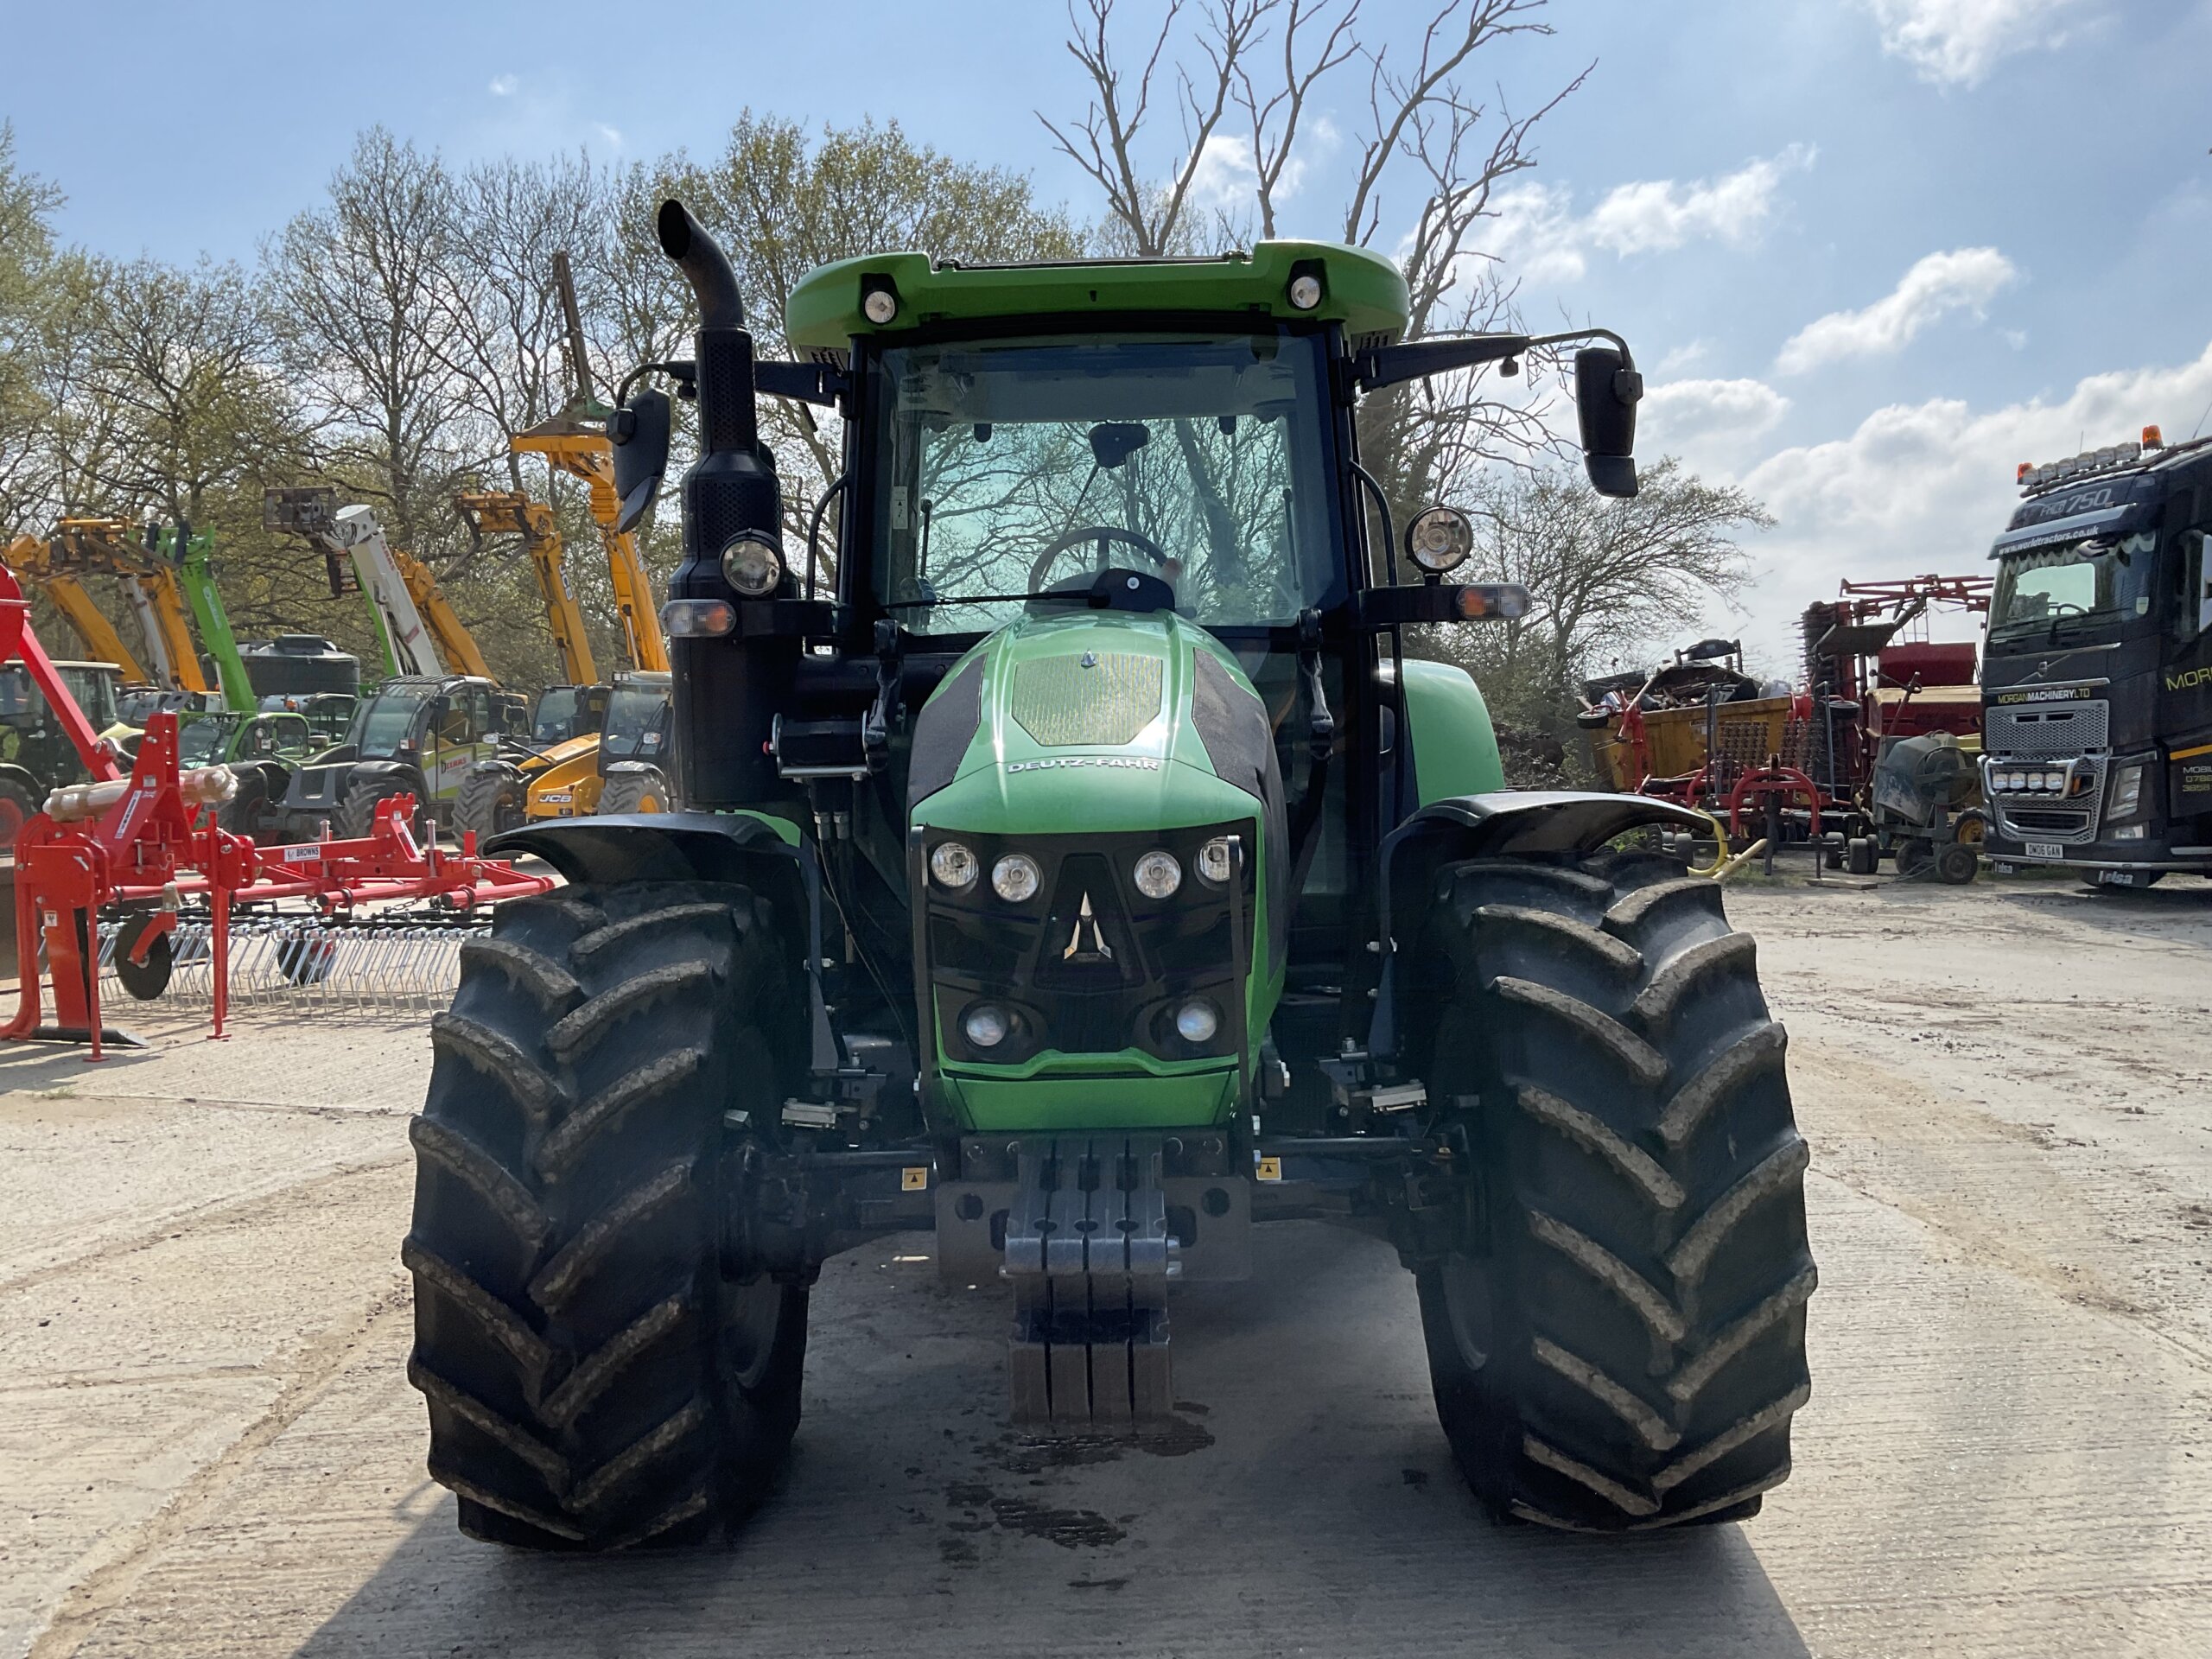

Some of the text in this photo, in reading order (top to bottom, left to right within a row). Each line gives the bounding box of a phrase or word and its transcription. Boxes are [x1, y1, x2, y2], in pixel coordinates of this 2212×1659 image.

[2066, 488, 2112, 512] 750
[1999, 525, 2100, 555] www.worldtractors.co.uk
[559, 563, 573, 601] JCB
[2166, 666, 2212, 691] MOR
[1007, 759, 1159, 773] DEUTZ-FAHR
[538, 794, 573, 803] JCB
[296, 847, 319, 856] BROWNS
[2047, 845, 2061, 857] GAN
